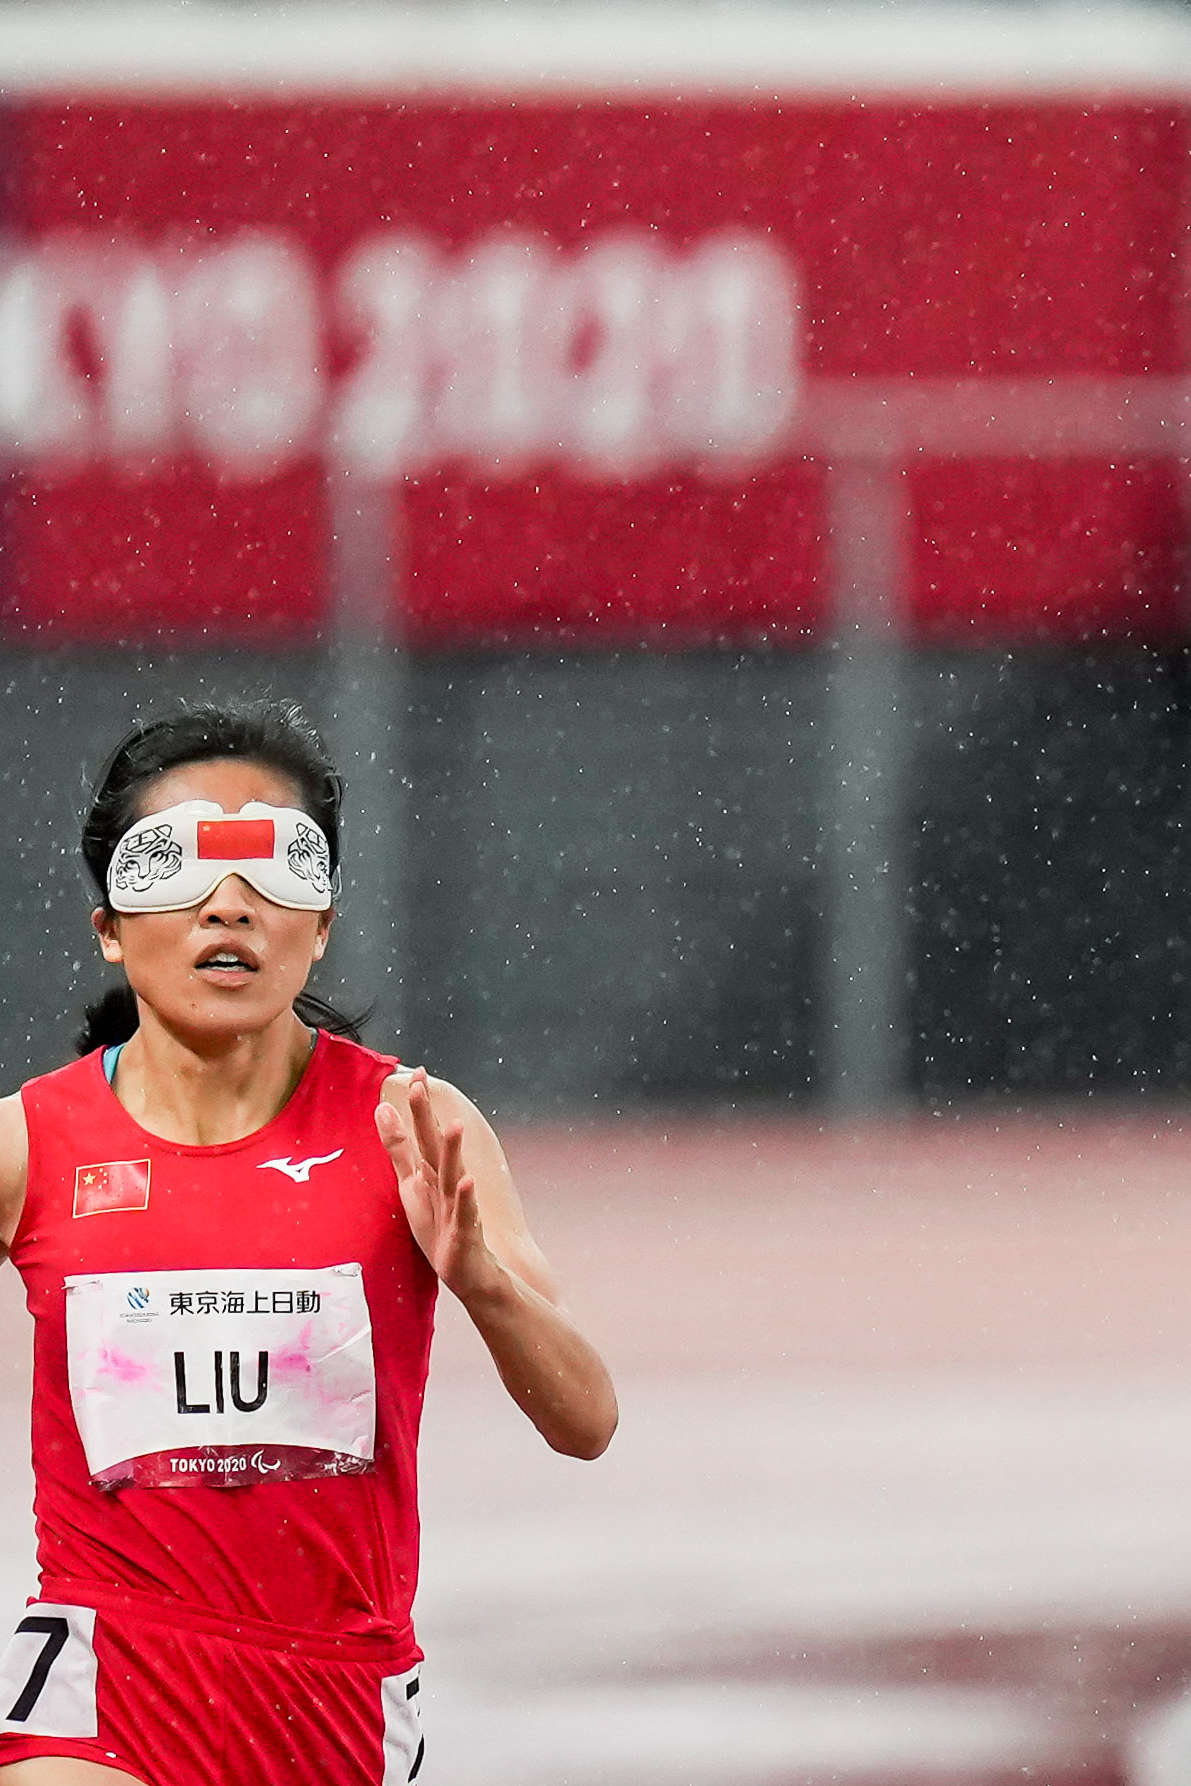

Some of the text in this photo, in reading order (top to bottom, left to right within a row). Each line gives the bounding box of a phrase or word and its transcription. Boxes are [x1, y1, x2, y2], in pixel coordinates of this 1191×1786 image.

[169, 1291, 321, 1316] 東京海上日動
[174, 1351, 268, 1414] LIU
[170, 1458, 247, 1473] TOKYO 2020
[6, 1616, 69, 1722] 7
